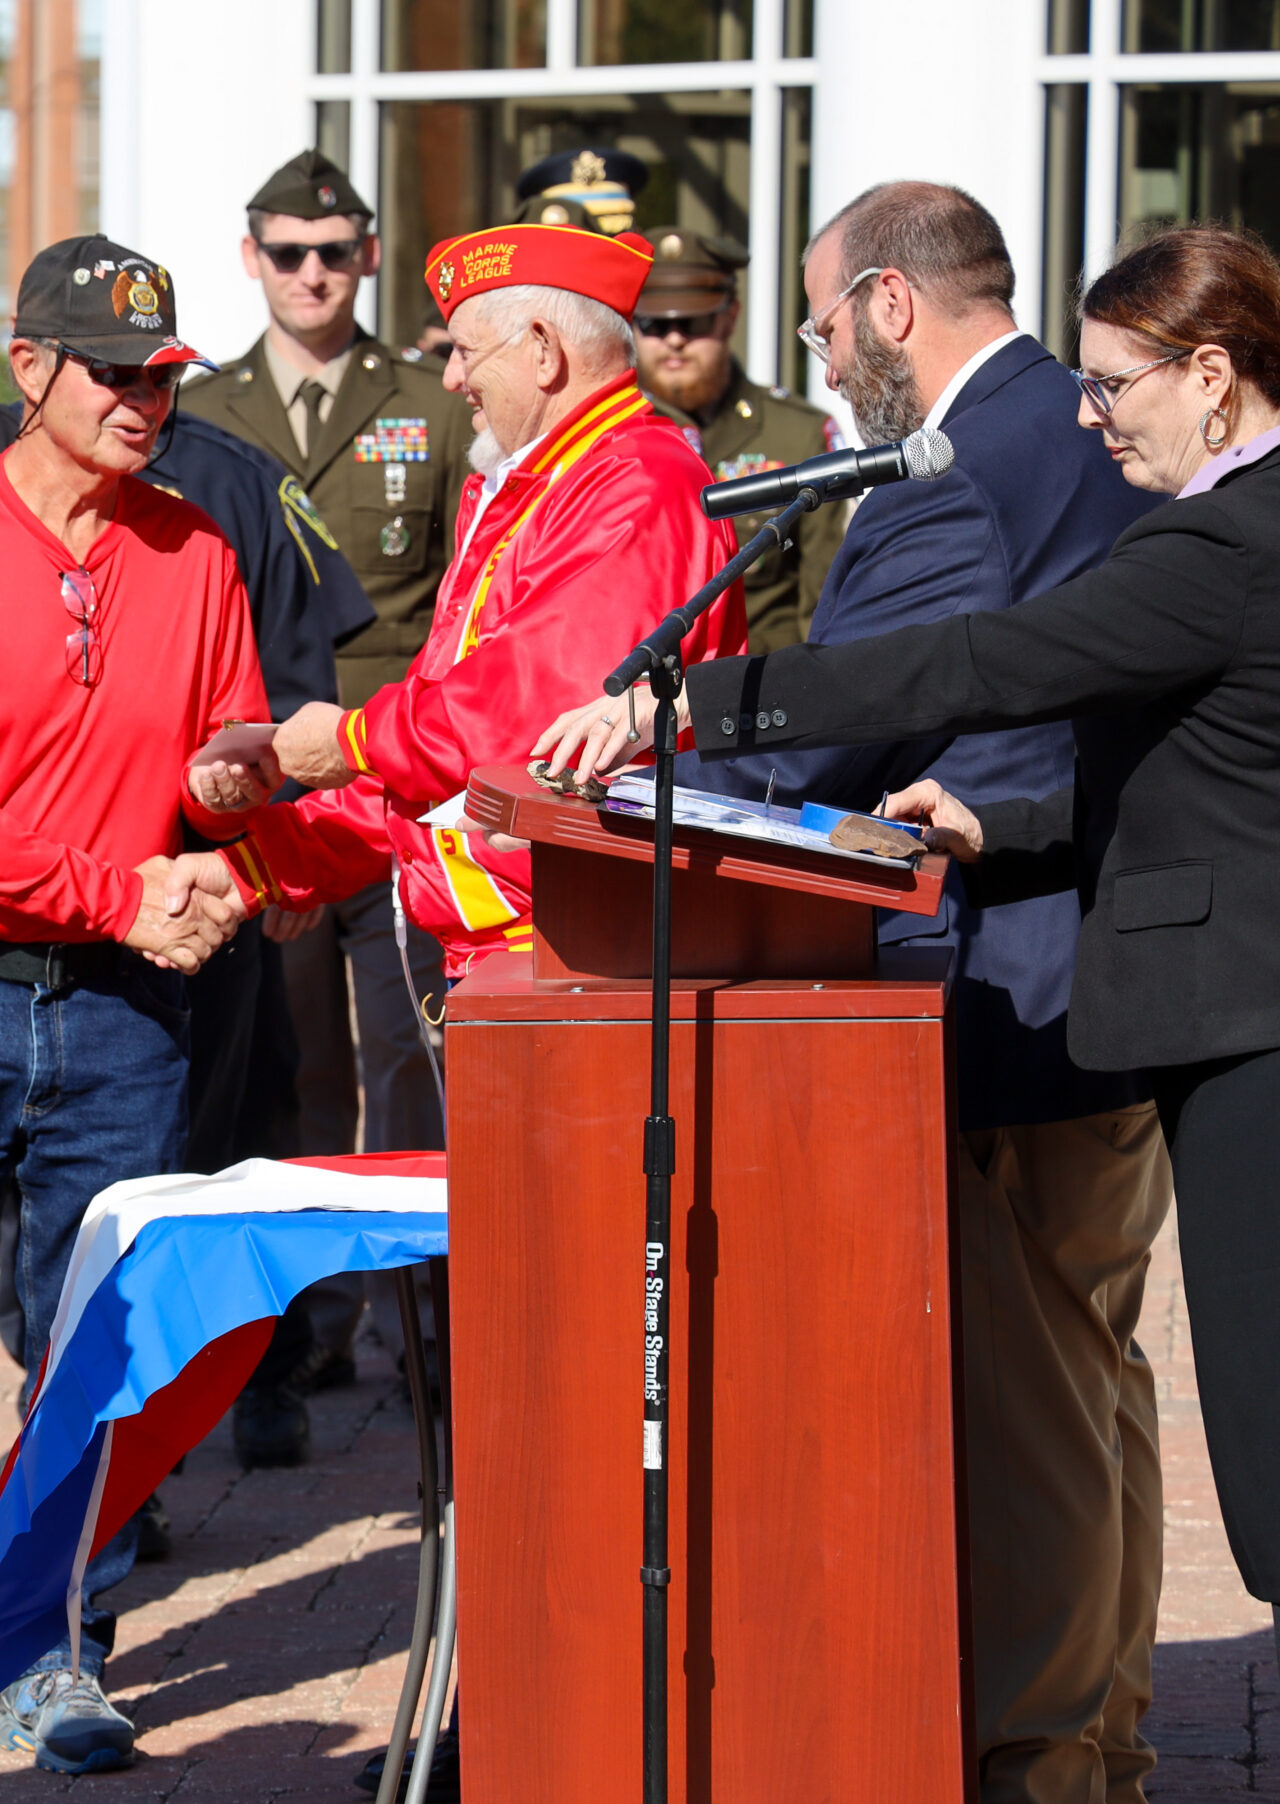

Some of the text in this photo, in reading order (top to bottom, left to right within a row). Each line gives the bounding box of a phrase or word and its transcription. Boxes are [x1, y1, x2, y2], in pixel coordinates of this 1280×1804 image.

[462, 243, 518, 265] MARINE
[465, 254, 511, 275] CORPS
[460, 264, 512, 288] LEAGUE
